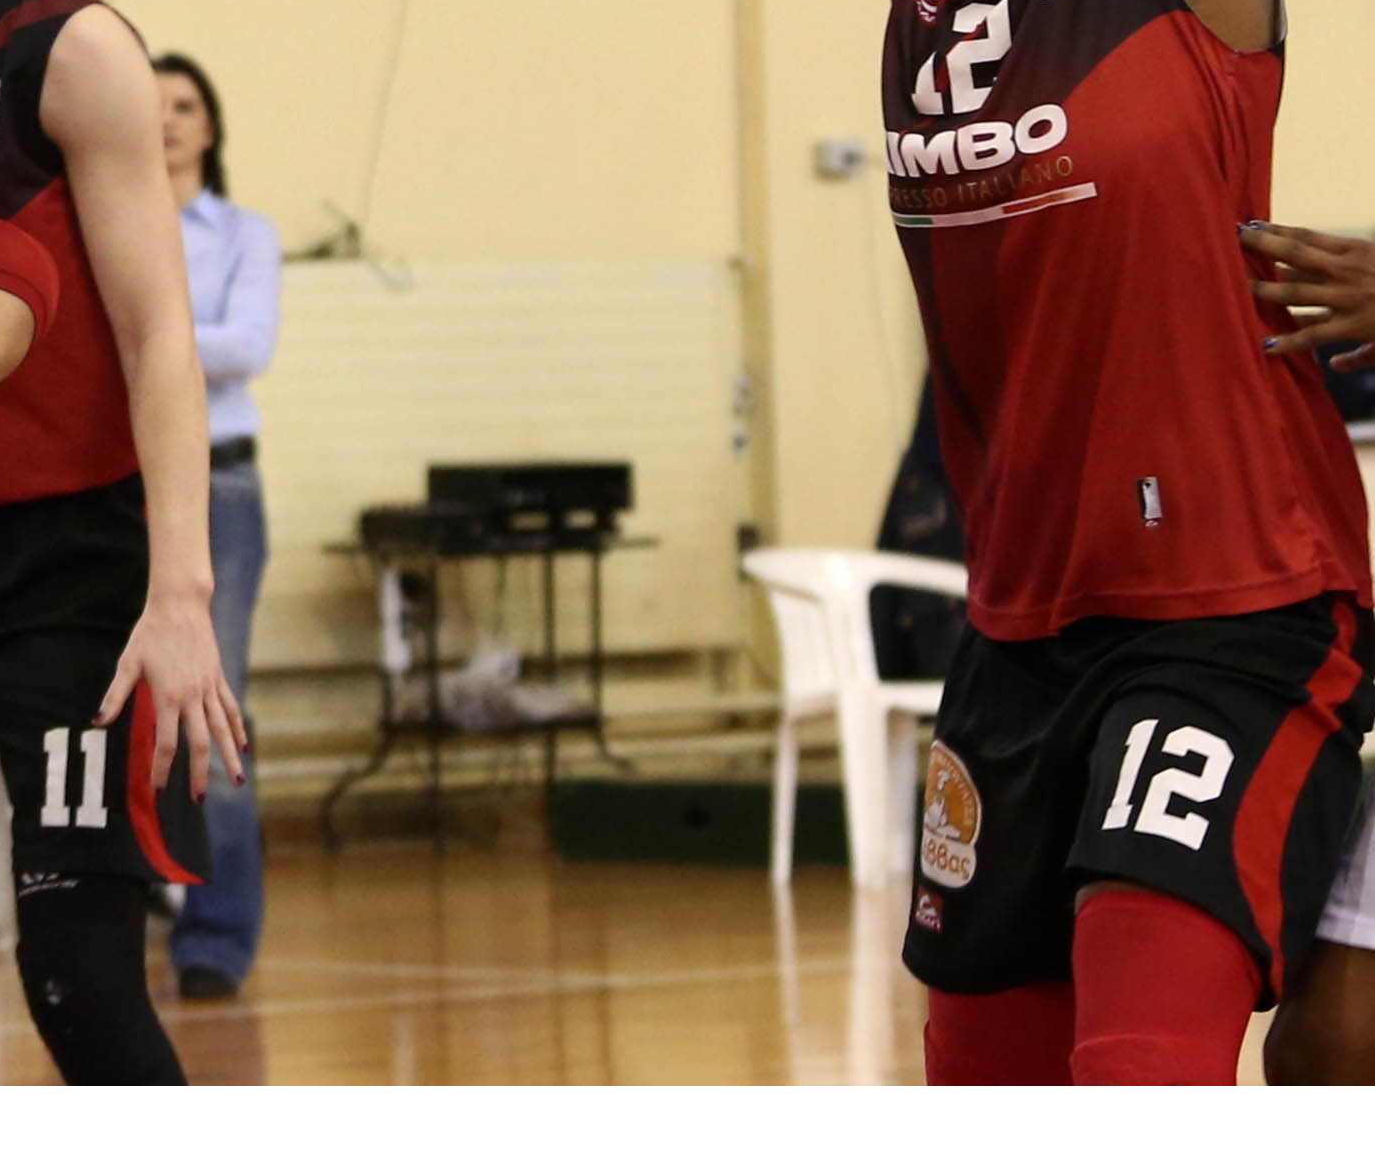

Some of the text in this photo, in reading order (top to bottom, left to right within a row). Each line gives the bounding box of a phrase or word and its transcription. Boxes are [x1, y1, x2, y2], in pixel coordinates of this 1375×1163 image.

[887, 104, 1069, 178] IMBO
[40, 727, 110, 829] 11
[1101, 719, 1236, 852] 12
